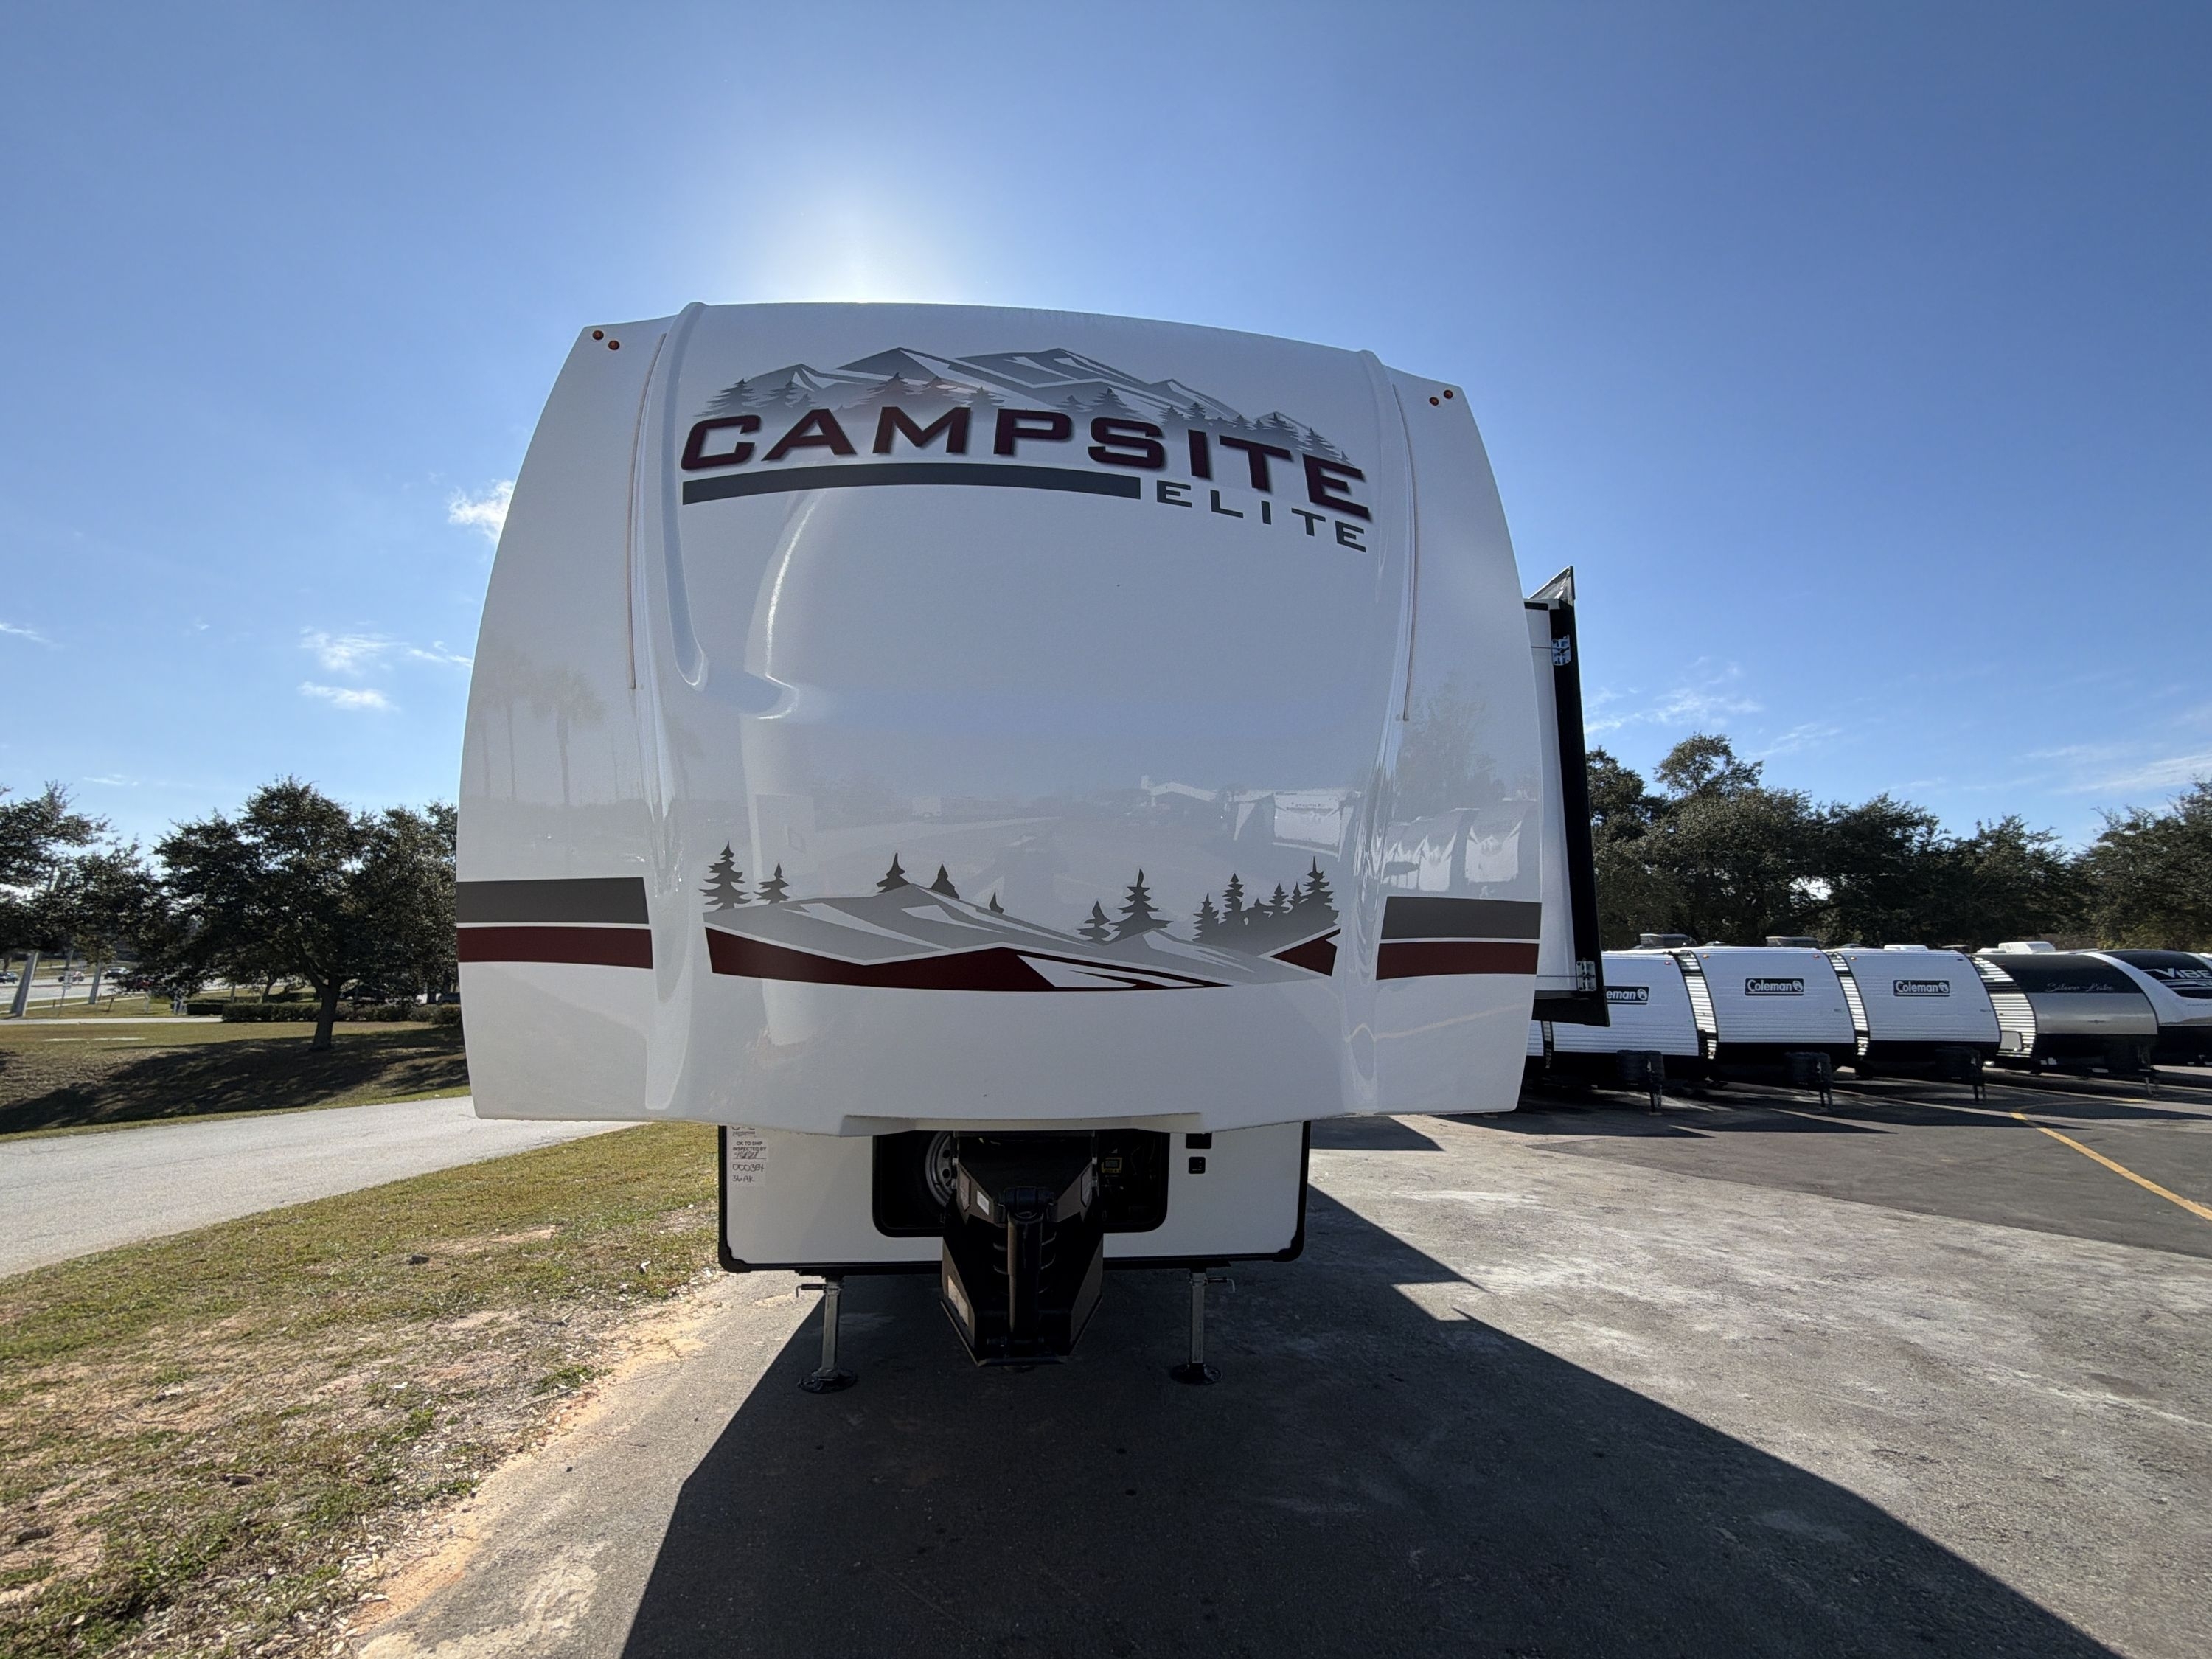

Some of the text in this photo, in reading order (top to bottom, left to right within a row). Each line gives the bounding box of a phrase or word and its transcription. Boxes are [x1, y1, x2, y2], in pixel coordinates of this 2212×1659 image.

[681, 406, 1370, 520] CAMPSITE
[1156, 479, 1366, 553] ELITE
[1747, 979, 1792, 992] Coleman
[1895, 981, 1939, 993] Coleman
[1606, 990, 1636, 1000] eman
